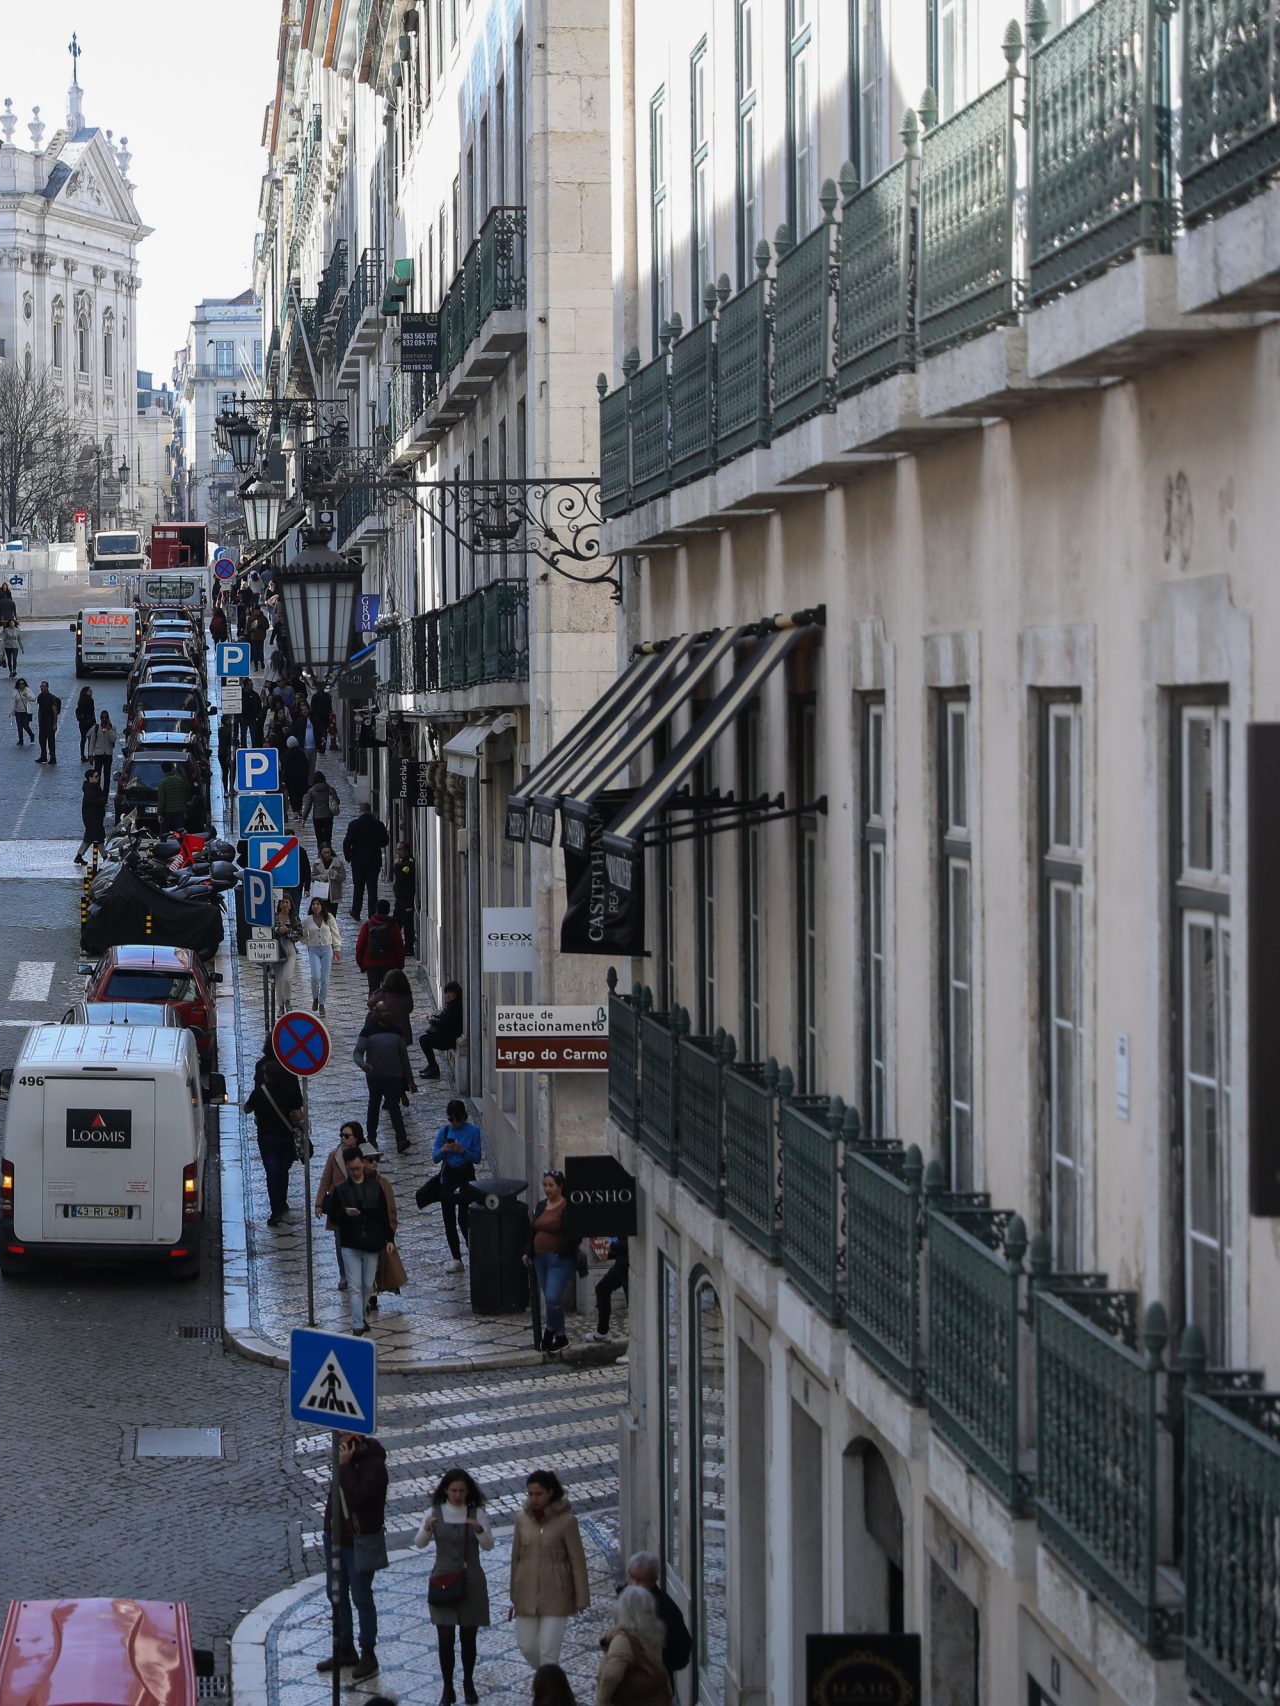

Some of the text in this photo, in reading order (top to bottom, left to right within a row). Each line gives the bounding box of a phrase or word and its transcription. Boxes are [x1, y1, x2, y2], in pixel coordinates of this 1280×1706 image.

[87, 615, 129, 625] NACEX
[360, 596, 371, 630] GROM
[222, 646, 243, 673] P
[244, 752, 269, 788] P
[417, 763, 428, 806] Bershka
[249, 875, 266, 919] P
[487, 932, 532, 941] GEOX
[497, 1010, 553, 1020] parque de
[497, 1020, 604, 1032] estacionamento
[497, 1048, 607, 1062] Largo do Carmo
[19, 1076, 44, 1086] 496
[72, 1129, 125, 1142] LOOMIS
[570, 1188, 632, 1204] OYSHO
